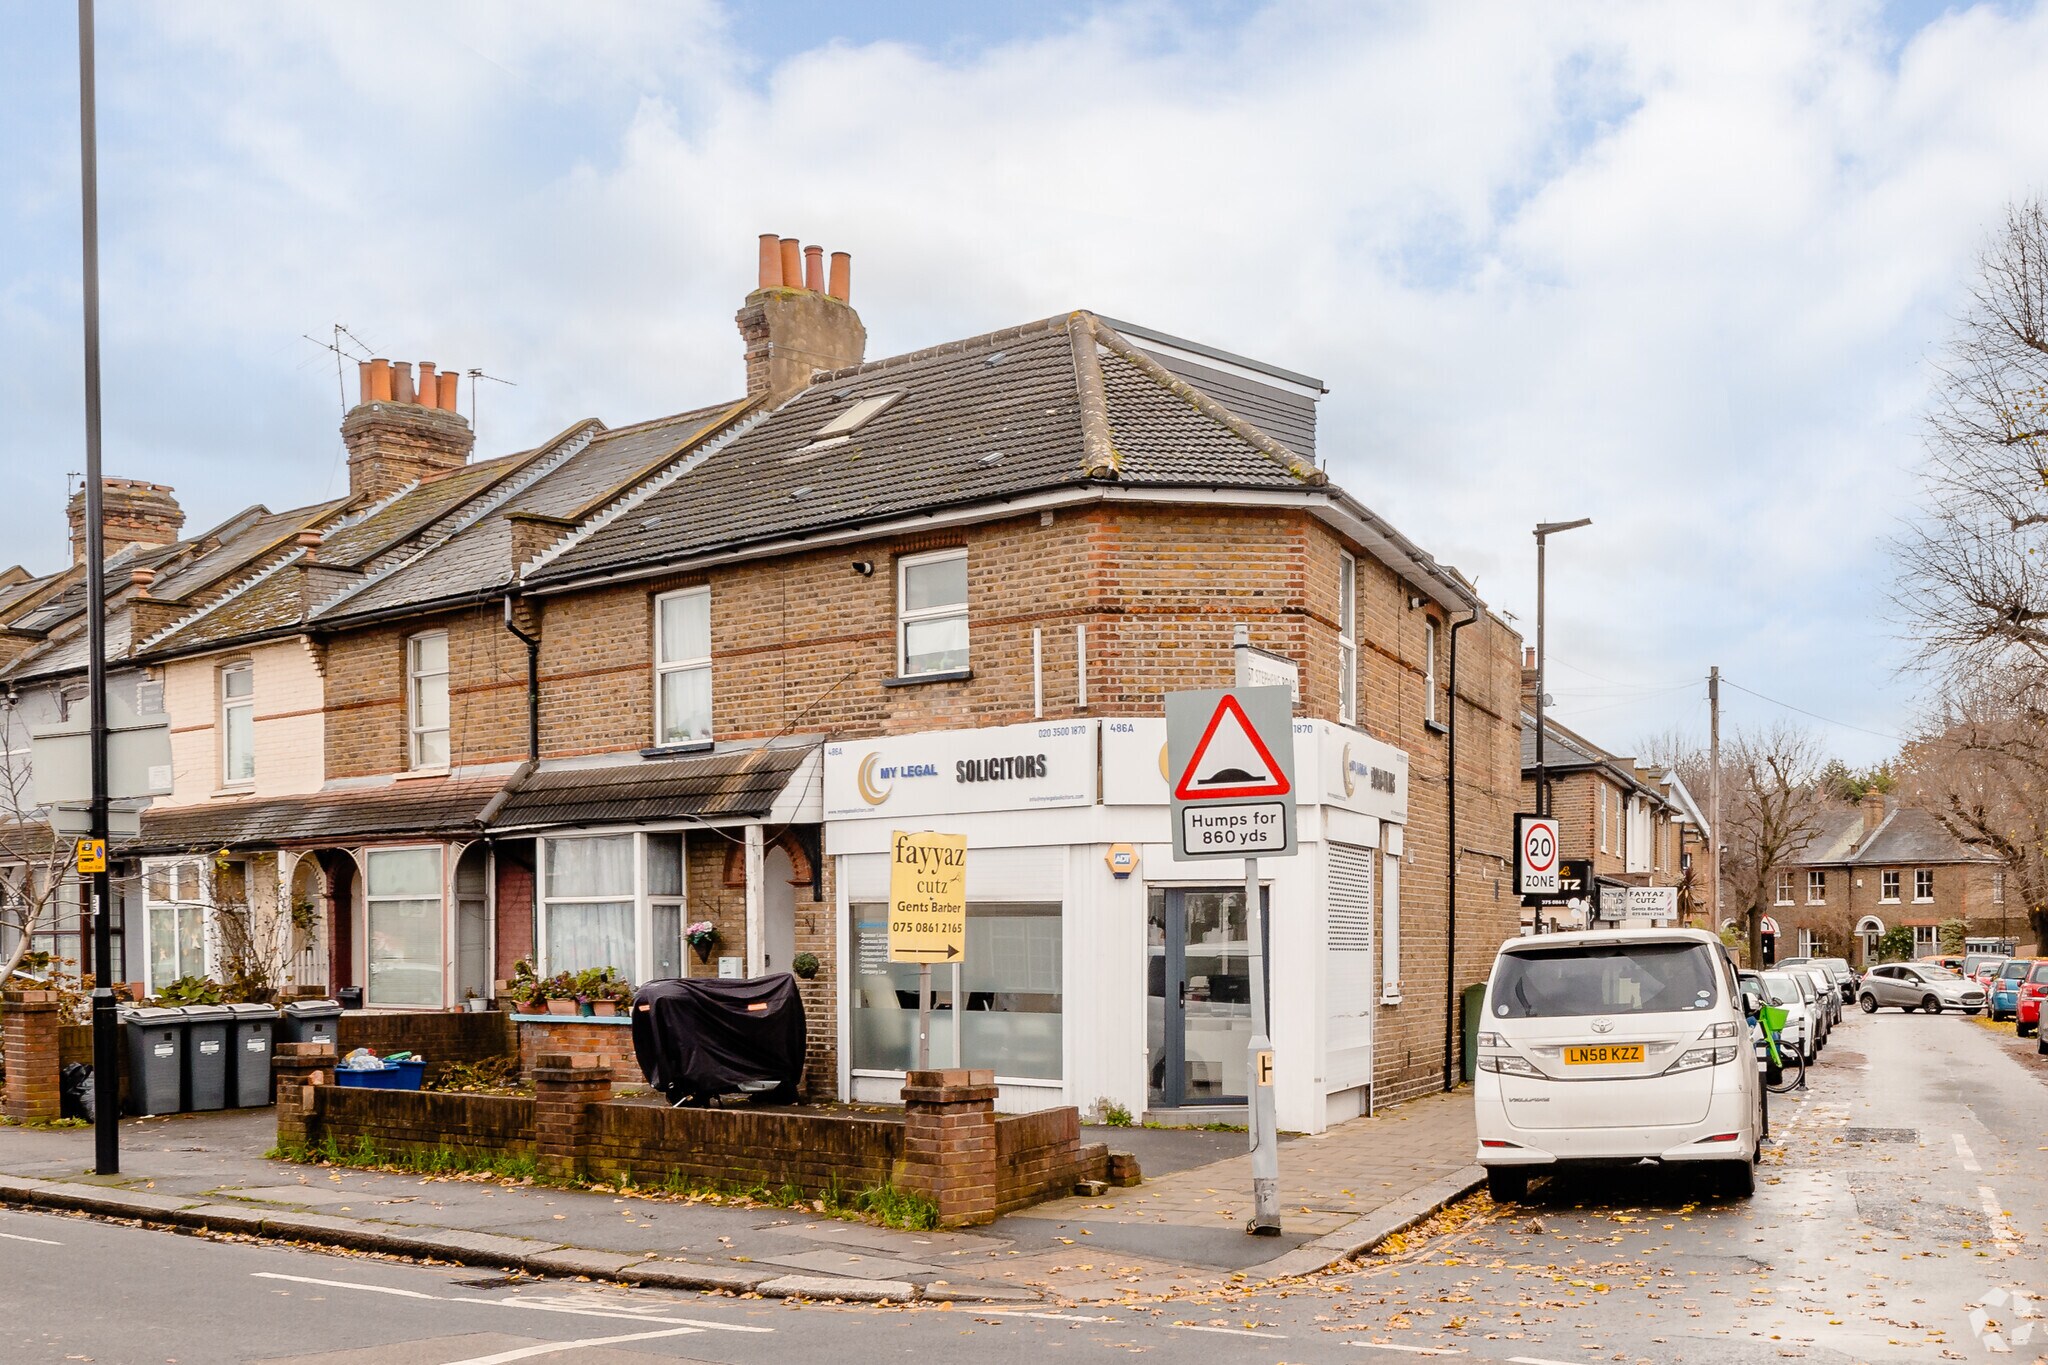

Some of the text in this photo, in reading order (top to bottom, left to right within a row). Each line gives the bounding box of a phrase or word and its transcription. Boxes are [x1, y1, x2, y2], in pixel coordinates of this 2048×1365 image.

[1038, 725, 1086, 738] 020 3500 1870
[1110, 723, 1135, 733] 486A
[1293, 724, 1313, 734] 1870
[880, 754, 1047, 783] MY LEGAL SOLICITORS
[1192, 812, 1276, 828] Humps for
[1203, 829, 1267, 845] 860 yds
[1530, 838, 1551, 857] 20
[895, 836, 965, 874] fayyaz
[1115, 854, 1130, 863] ADT
[917, 879, 948, 894] cutz
[1526, 876, 1554, 887] ZONE
[897, 901, 961, 913] Gents Barber
[892, 922, 912, 932] 075
[916, 922, 939, 933] 0861
[942, 923, 962, 933] 2165
[1570, 1047, 1639, 1062] LN58 KZZ
